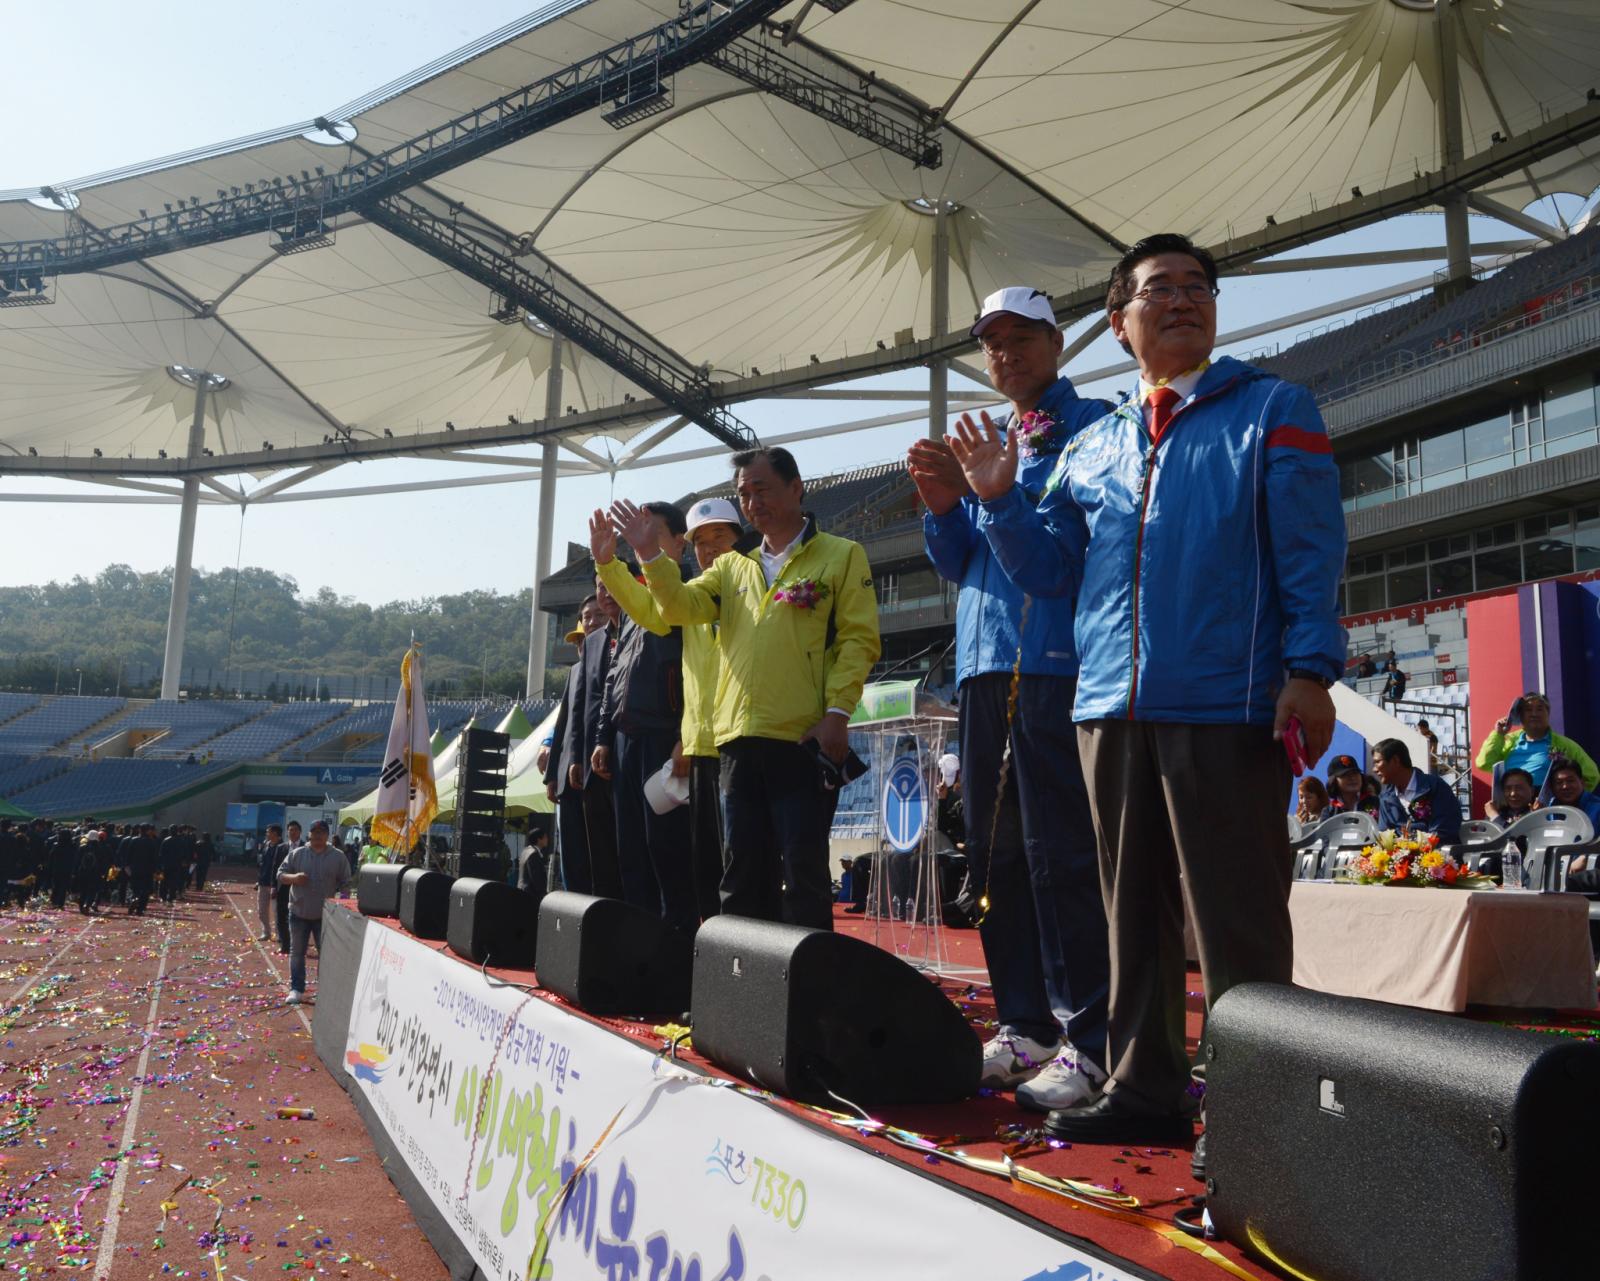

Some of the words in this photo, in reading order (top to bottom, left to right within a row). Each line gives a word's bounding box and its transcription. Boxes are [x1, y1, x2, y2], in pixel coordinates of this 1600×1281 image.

[322, 768, 333, 782] A
[376, 998, 398, 1055] 2012
[399, 1013, 453, 1118] 인천광역시
[751, 1156, 807, 1231] 7330
